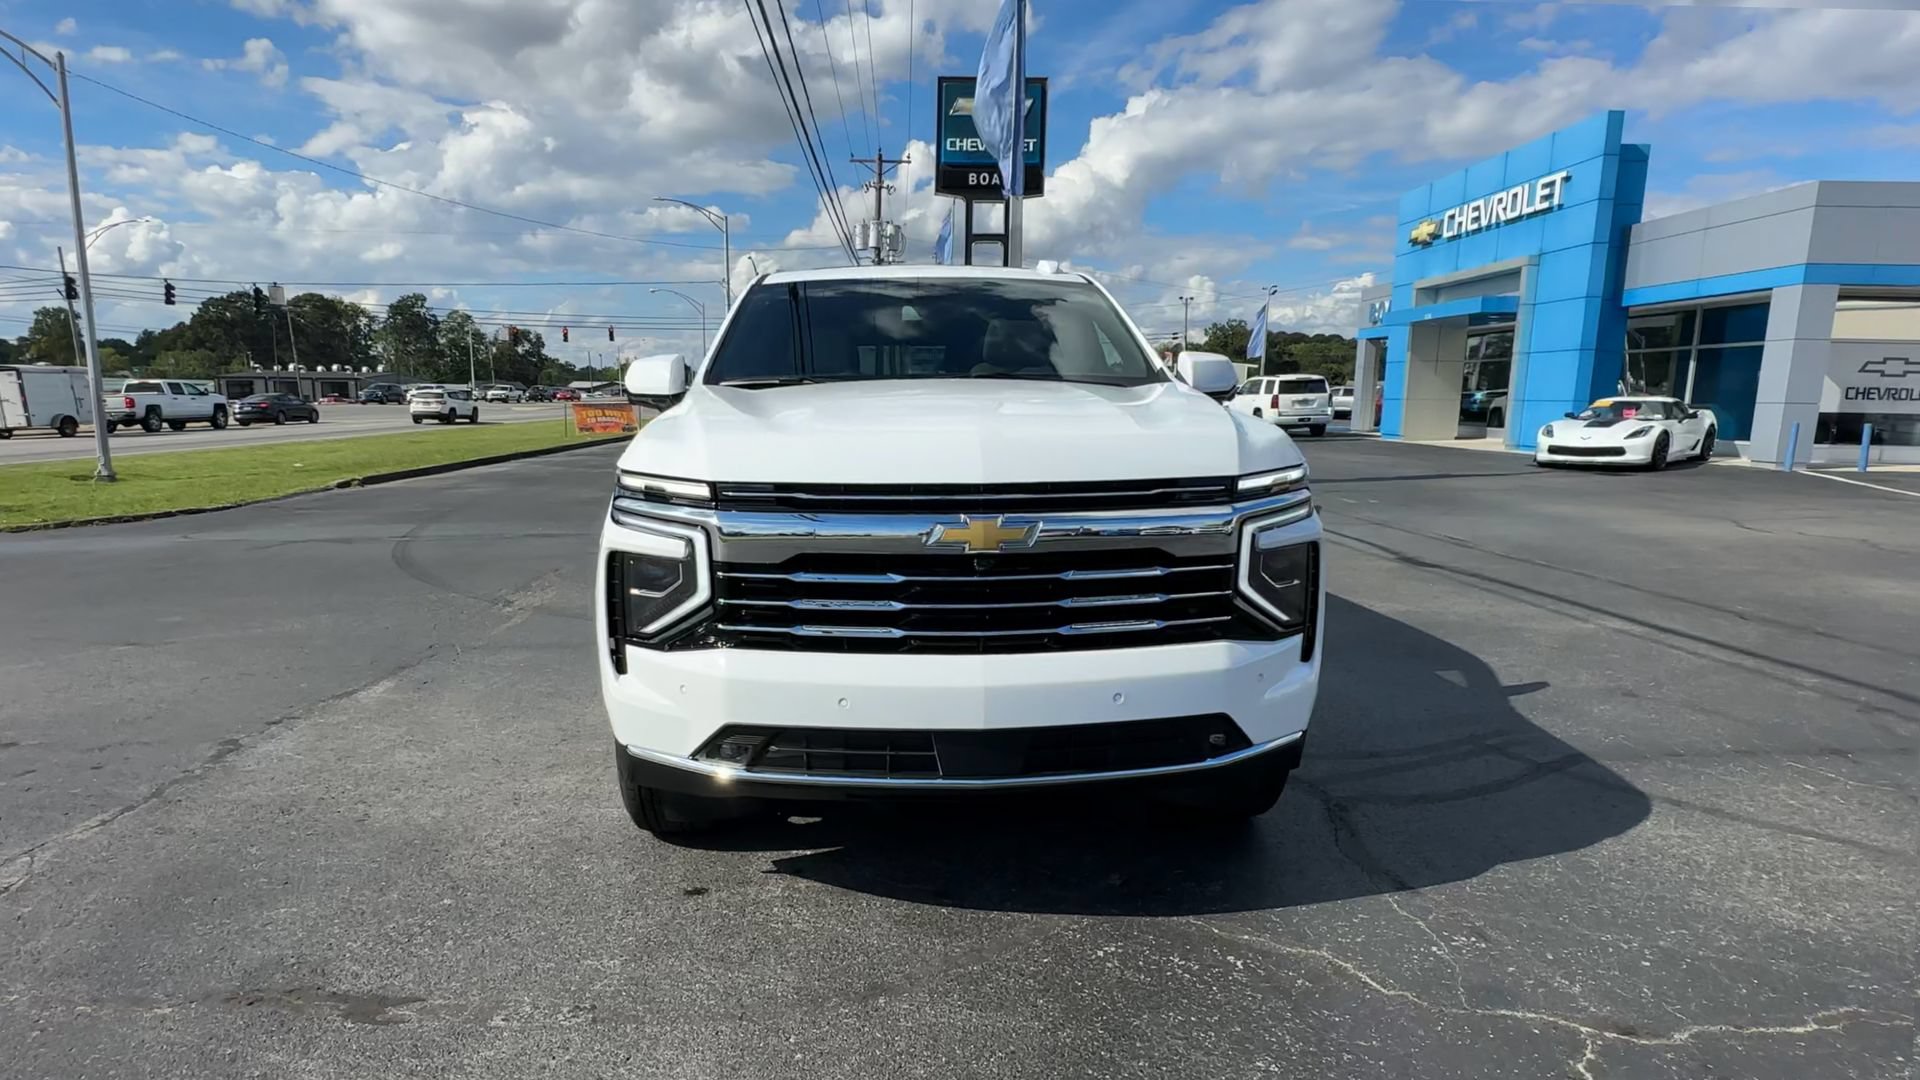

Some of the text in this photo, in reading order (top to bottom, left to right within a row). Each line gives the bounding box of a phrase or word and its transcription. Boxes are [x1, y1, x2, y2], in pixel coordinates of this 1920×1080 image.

[968, 172, 1001, 185] BOA
[1442, 170, 1568, 239] CHEVROLET
[1845, 386, 1920, 401] CHEVROL
